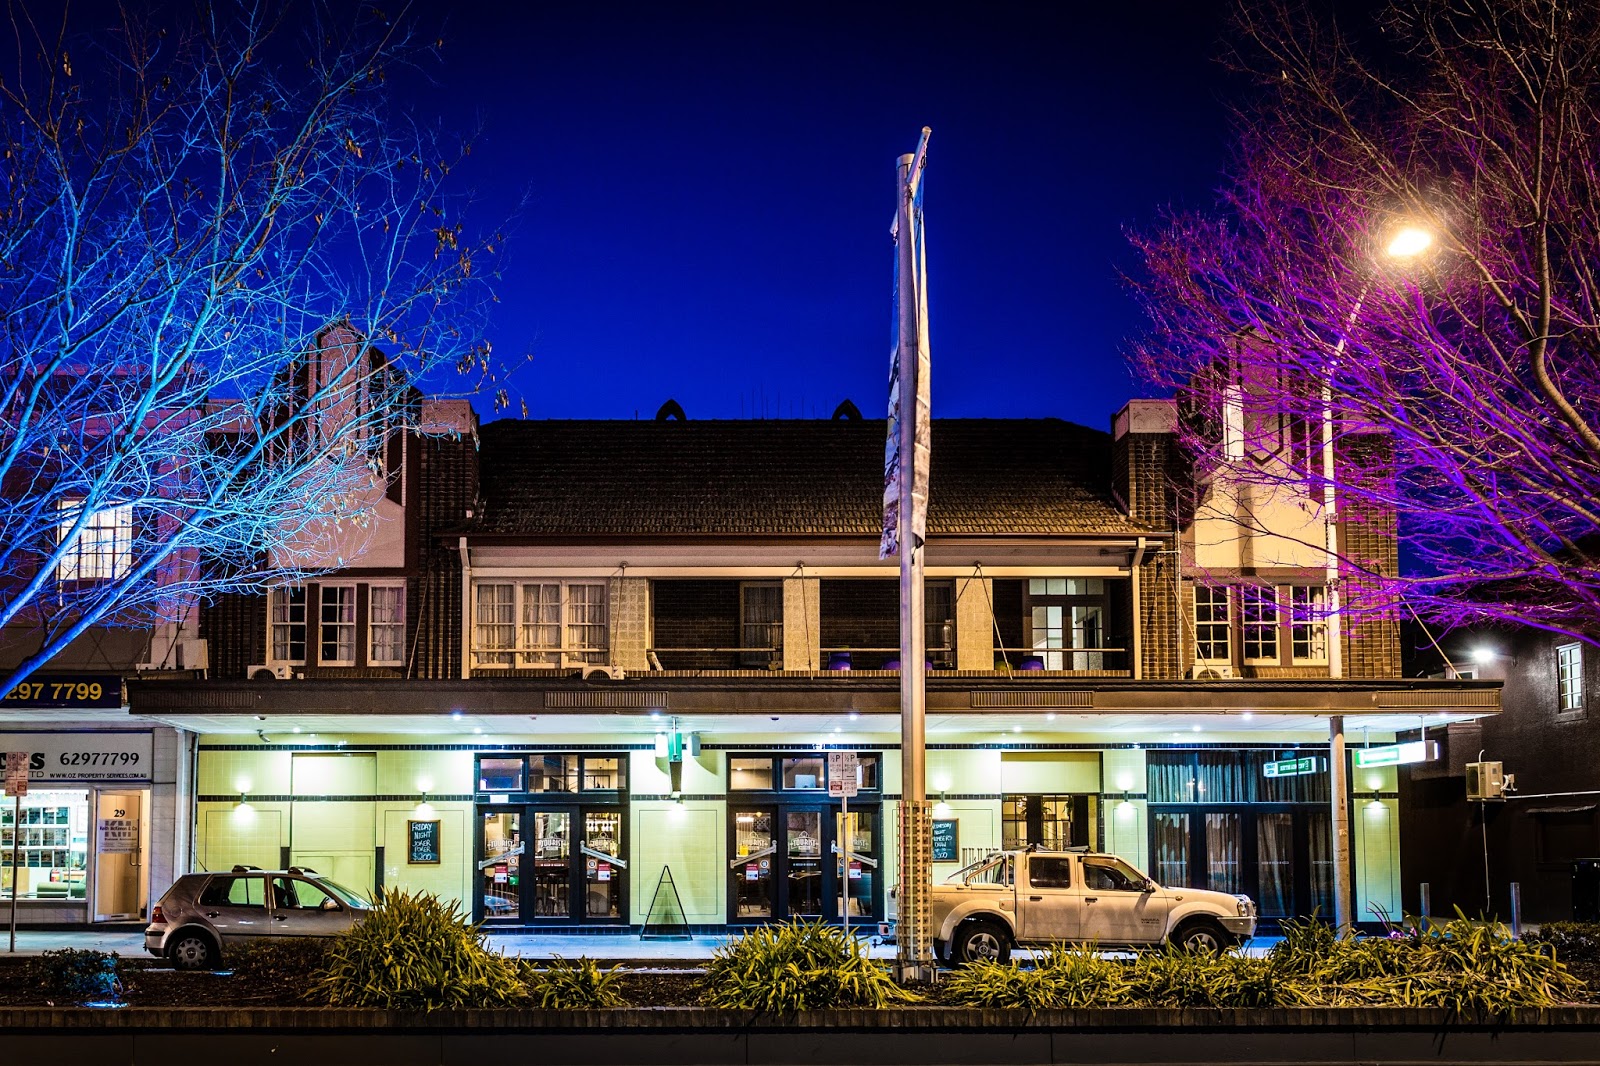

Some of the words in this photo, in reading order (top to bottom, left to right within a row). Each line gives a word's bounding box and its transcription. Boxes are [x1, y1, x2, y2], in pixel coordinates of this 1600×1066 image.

[51, 683, 102, 700] 7799
[60, 752, 140, 766] 62977799
[114, 809, 126, 818] 29
[411, 822, 433, 832] FRIDAY
[414, 831, 432, 840] NIGHT
[490, 839, 513, 848] TOURIST
[793, 838, 815, 847] TOURIST
